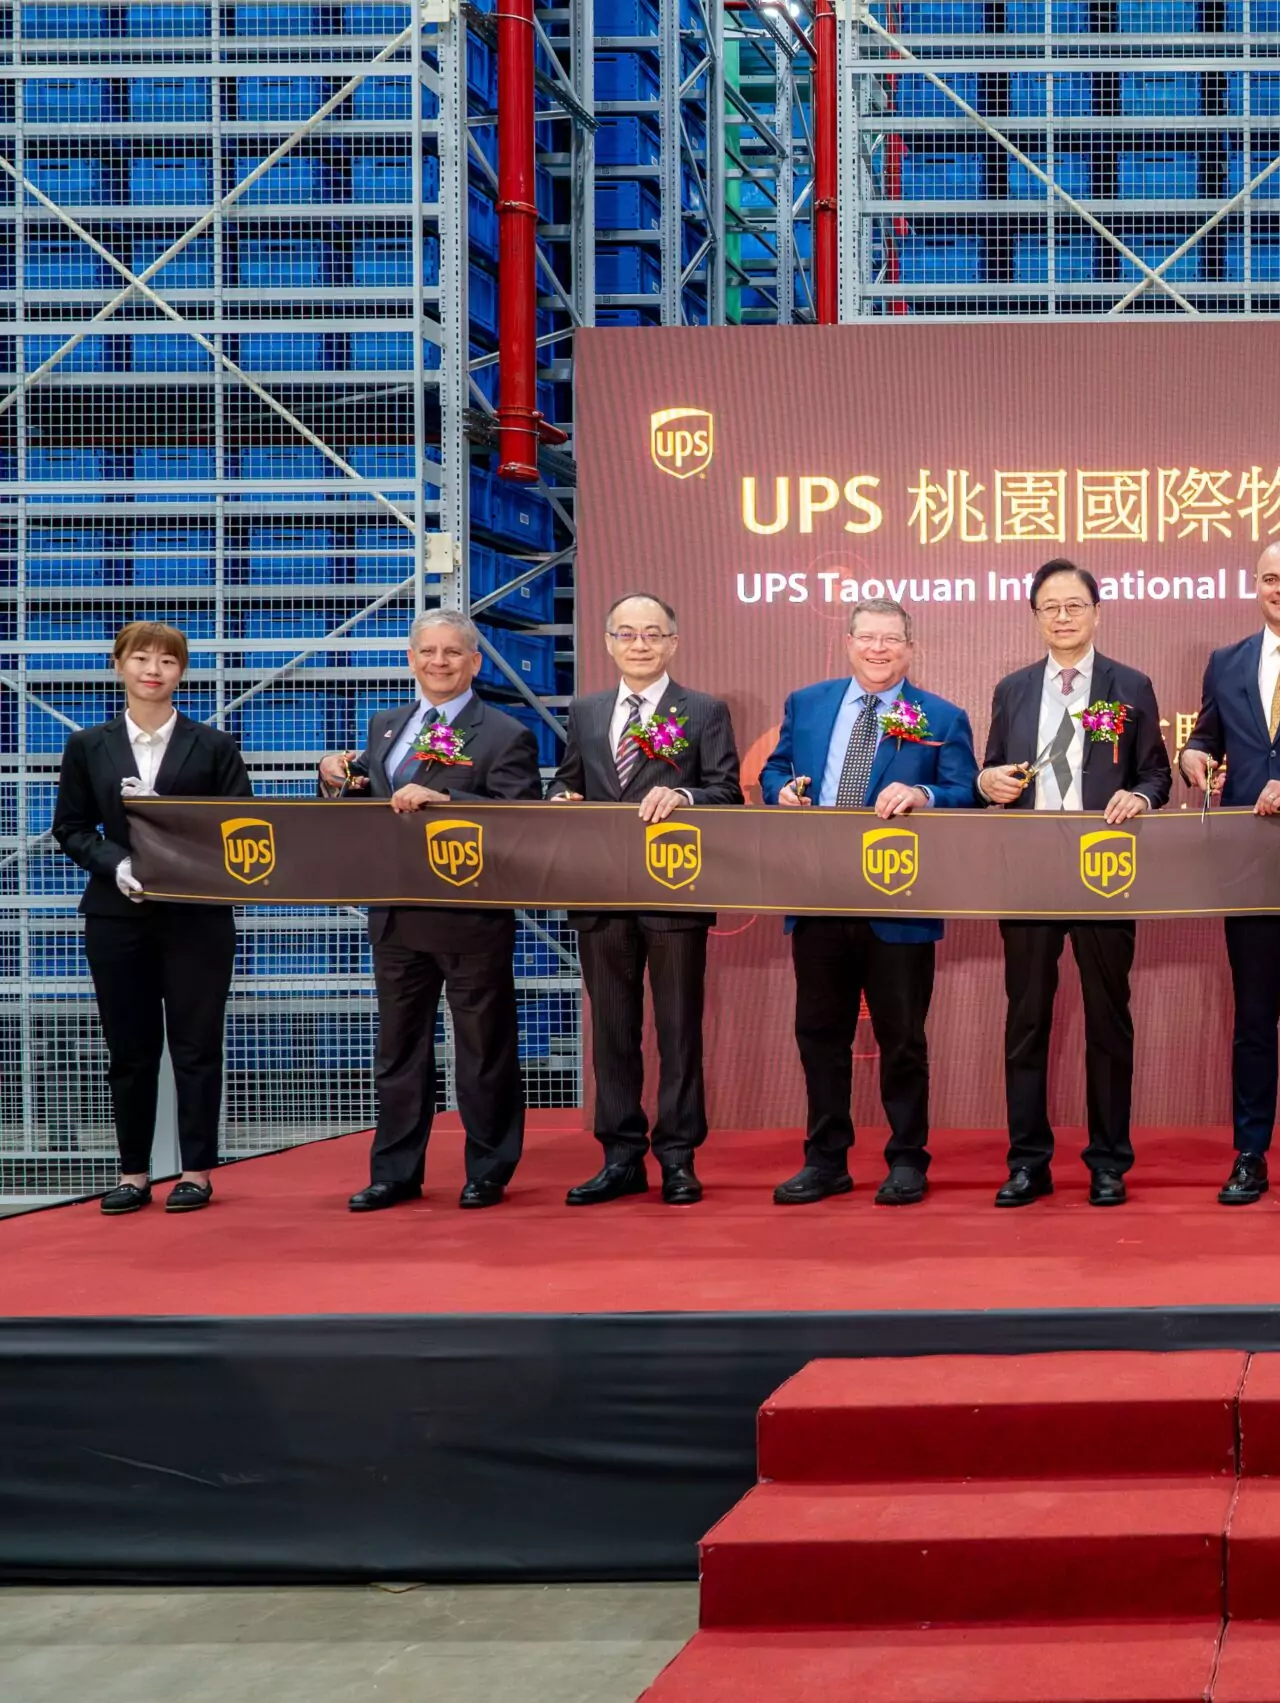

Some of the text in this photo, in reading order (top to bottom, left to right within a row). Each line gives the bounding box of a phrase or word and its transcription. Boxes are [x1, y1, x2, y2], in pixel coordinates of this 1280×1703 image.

[655, 429, 708, 468] ups
[741, 474, 884, 535] UPS
[736, 572, 809, 604] UPS
[988, 567, 1226, 601] Intational
[226, 838, 272, 873] ups
[430, 839, 479, 875] ups
[649, 843, 697, 879] ups
[867, 848, 914, 884] ups
[1084, 851, 1132, 887] ups
